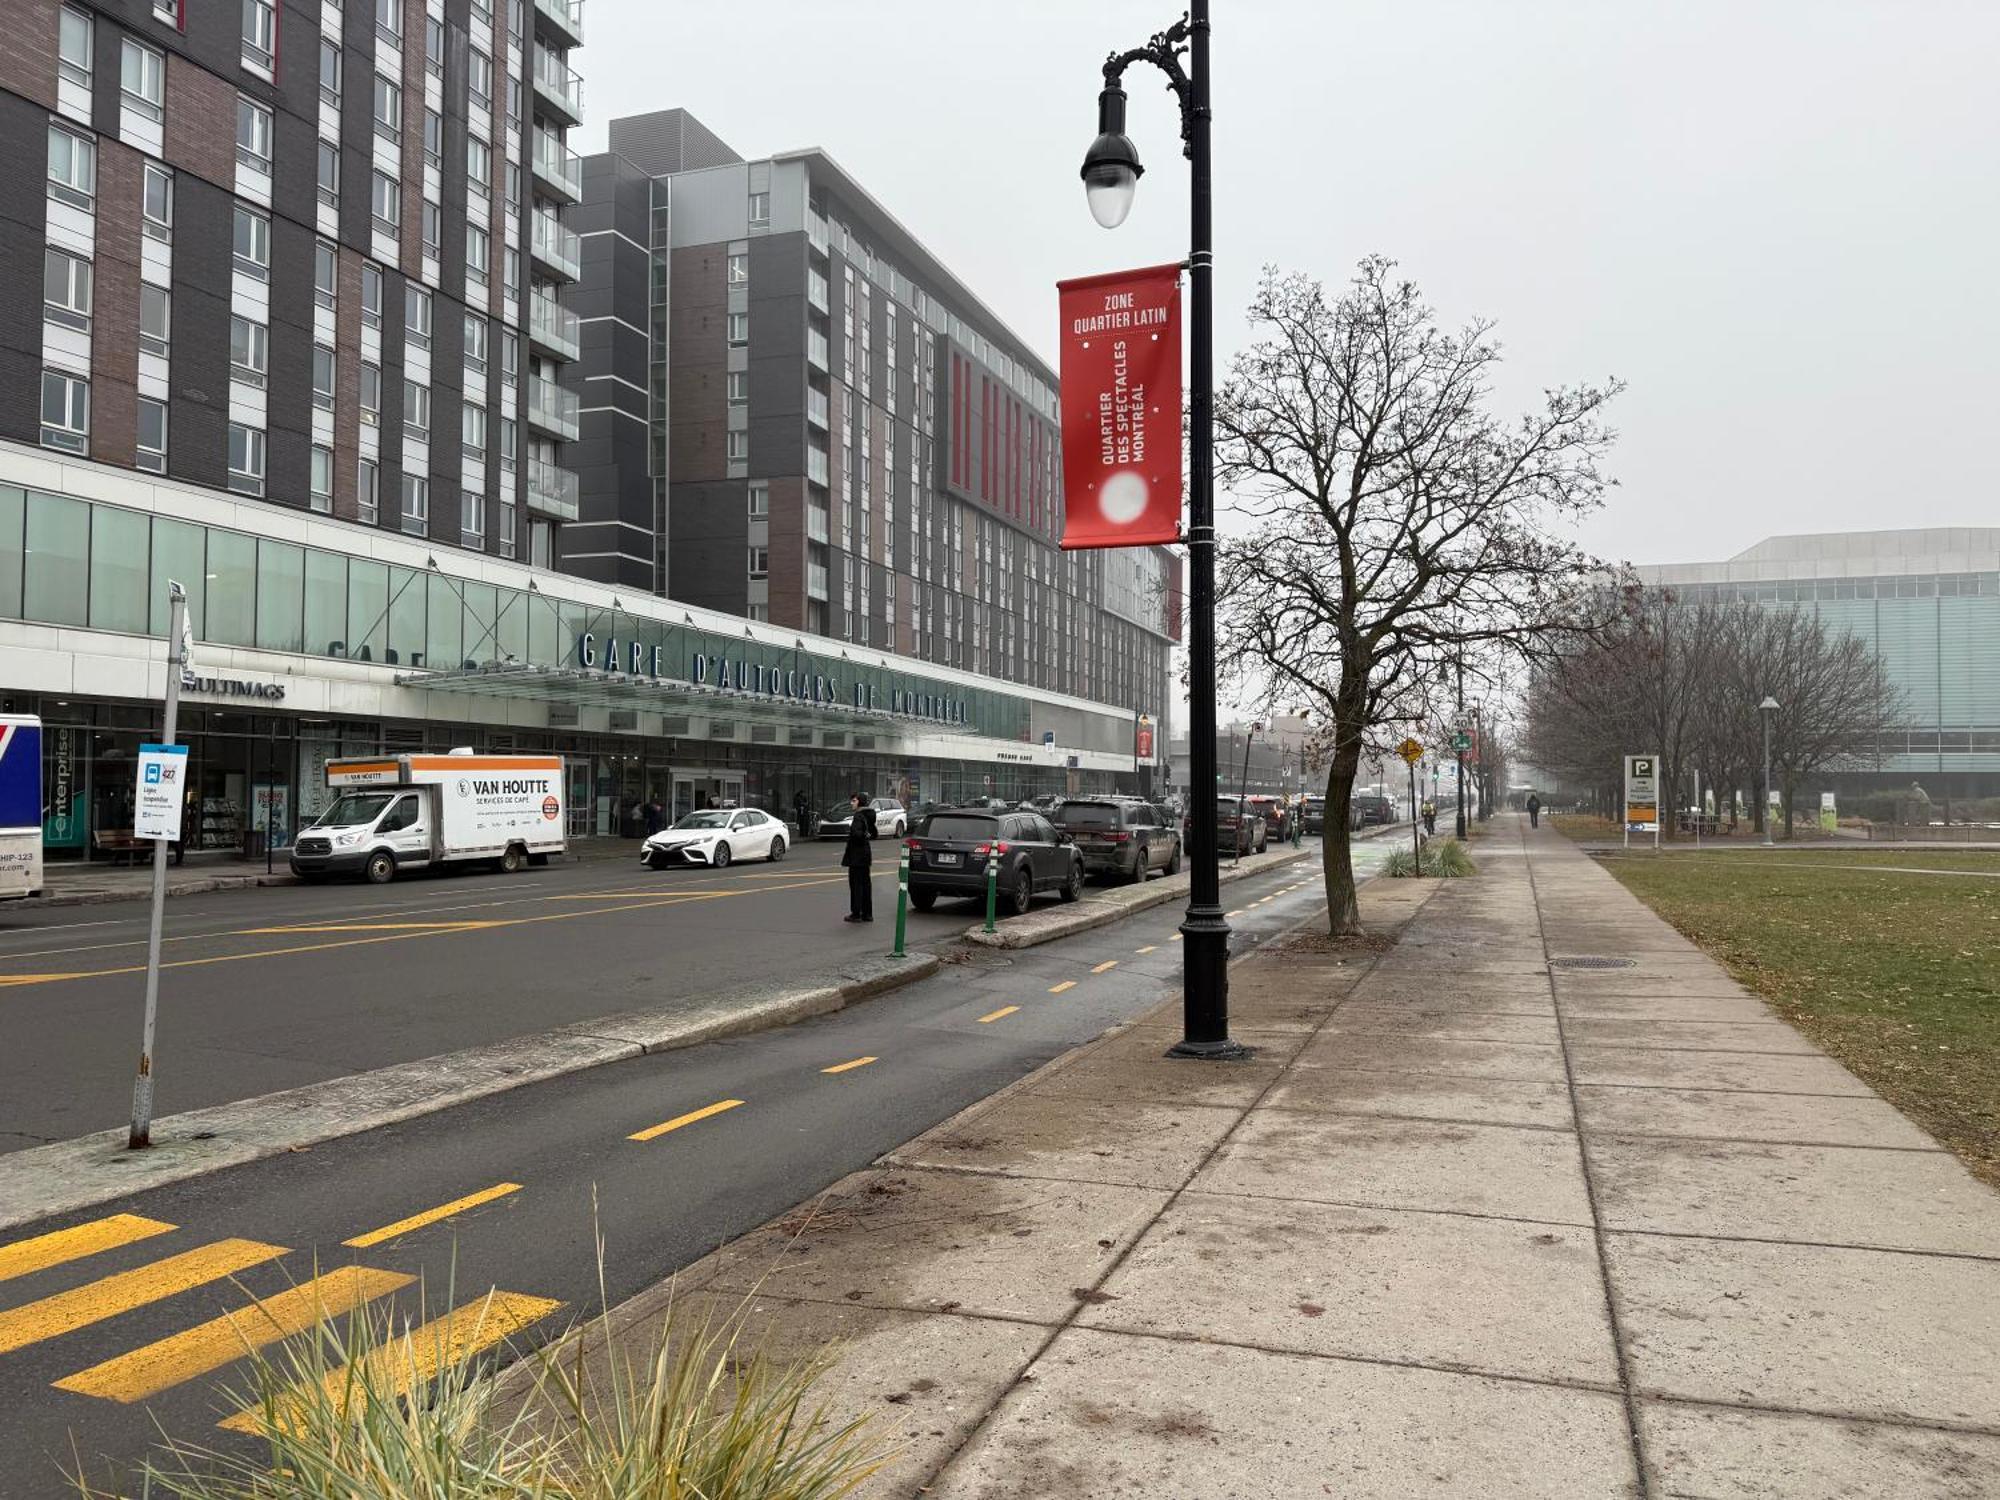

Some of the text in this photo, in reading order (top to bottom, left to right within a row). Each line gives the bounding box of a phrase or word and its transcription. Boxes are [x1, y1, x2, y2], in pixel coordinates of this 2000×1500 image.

[1074, 306, 1167, 335] QUARTIER LATIN
[1104, 293, 1134, 311] ZONE
[1114, 340, 1129, 464] DES SPECTACLES
[1128, 383, 1145, 463] MONTRÉAL
[1100, 392, 1114, 465] QUARTIER
[183, 677, 285, 699] MULTIMAGS
[580, 632, 968, 723] GARE D'AUTOCARS DE MONTRÉAL
[55, 728, 71, 833] enterprise
[473, 779, 549, 795] VAN HOUTTE
[476, 794, 529, 805] SERVICES DE CAFÉ
